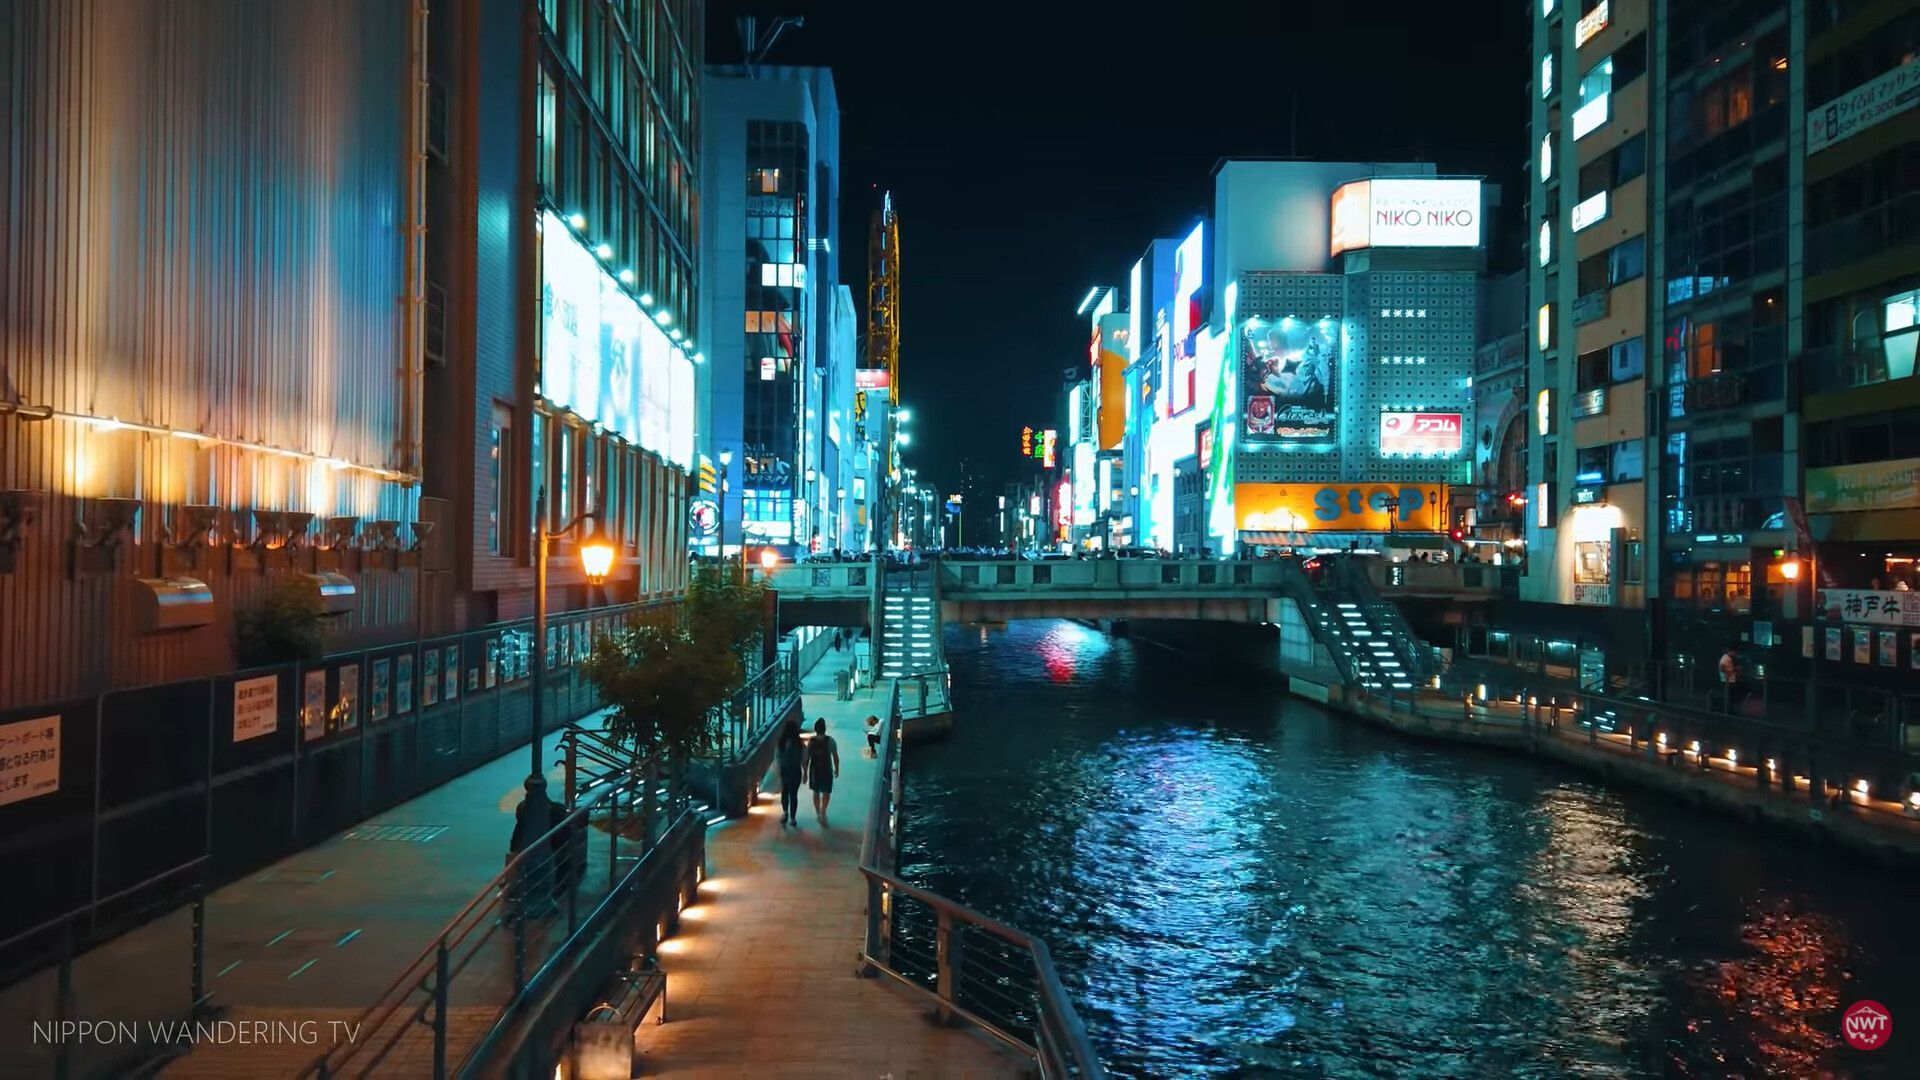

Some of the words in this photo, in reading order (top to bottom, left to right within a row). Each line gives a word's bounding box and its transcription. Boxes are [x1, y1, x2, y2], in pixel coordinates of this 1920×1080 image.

[1376, 209, 1421, 226] NIKO
[1427, 209, 1473, 226] NIKO
[1416, 418, 1457, 432] アコム
[1845, 593, 1900, 621] 神戸牛
